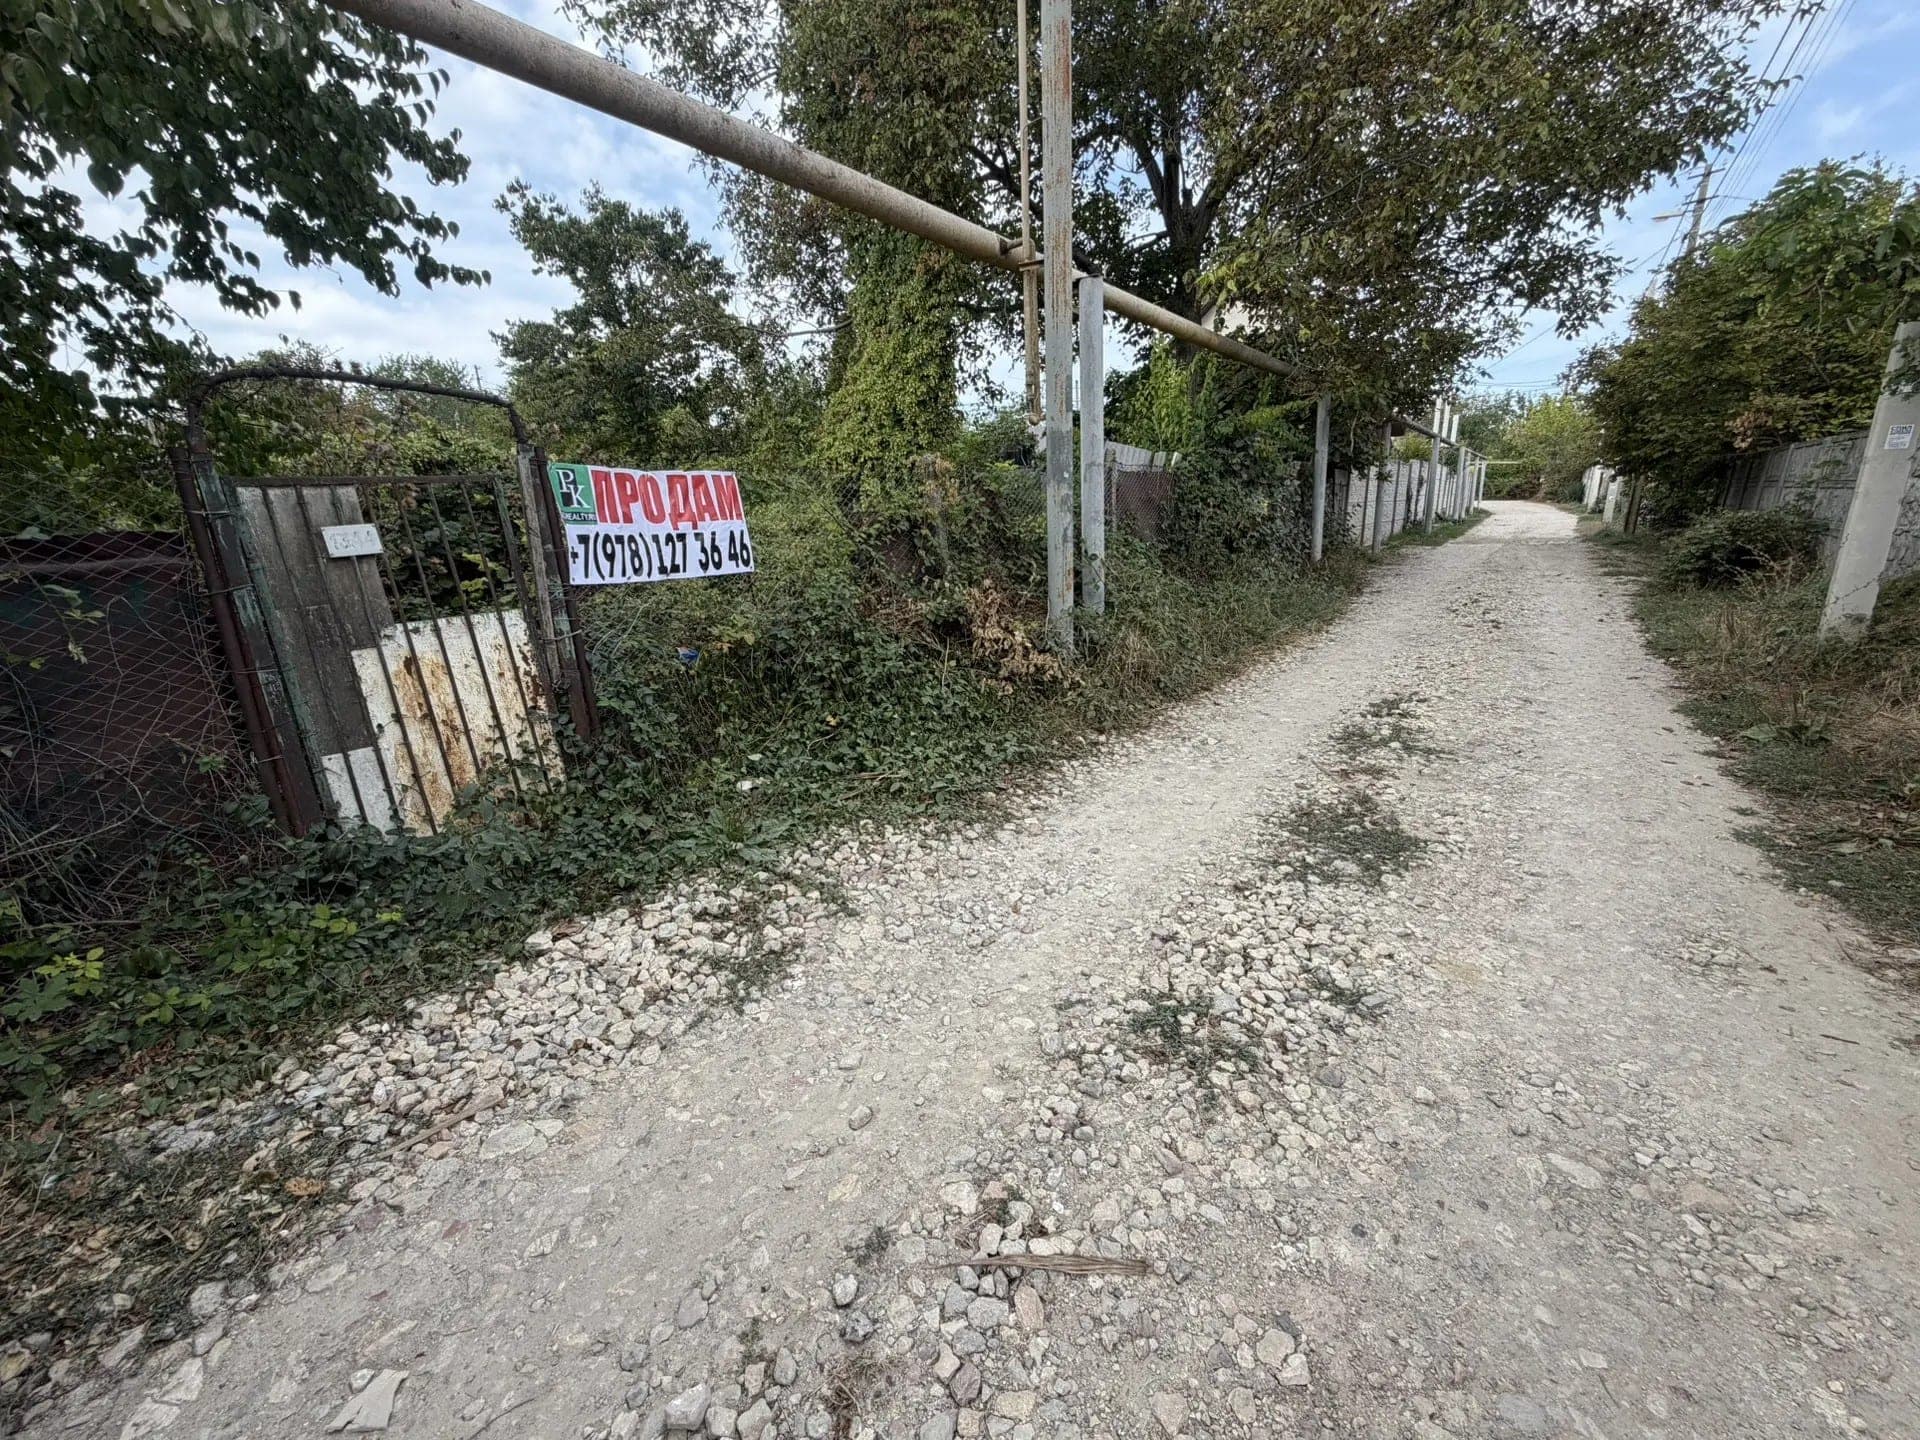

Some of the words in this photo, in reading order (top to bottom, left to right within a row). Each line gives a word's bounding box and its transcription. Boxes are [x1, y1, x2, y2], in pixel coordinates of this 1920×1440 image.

[591, 470, 743, 531] ПРОДАМ
[694, 531, 722, 572] 36
[728, 529, 751, 569] 46
